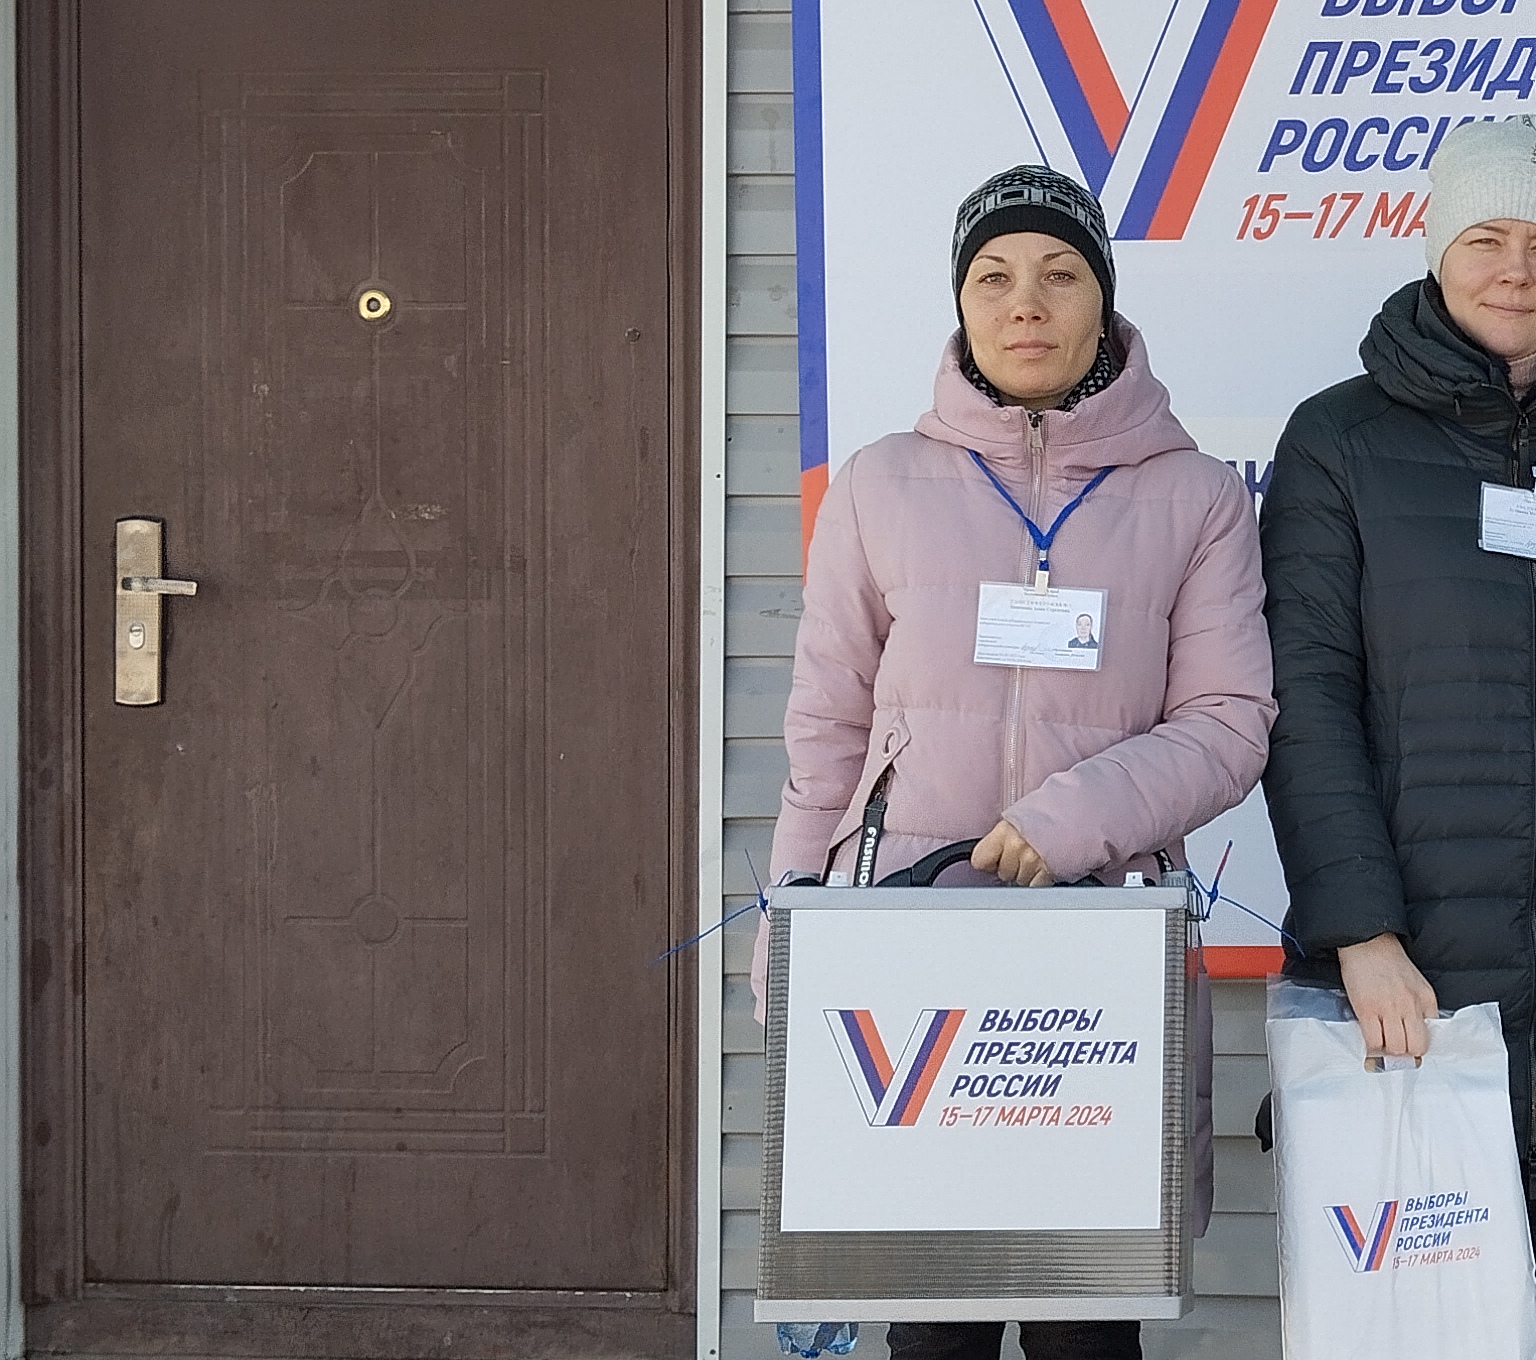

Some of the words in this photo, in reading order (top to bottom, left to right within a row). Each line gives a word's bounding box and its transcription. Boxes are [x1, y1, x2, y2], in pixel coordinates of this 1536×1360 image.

[1256, 114, 1517, 173] РОСС
[978, 1008, 1104, 1033] ВЫБОРЫ
[963, 1040, 1139, 1069] ПРЕЗИДЕНТА
[948, 1073, 1063, 1099] РОССИИ
[993, 1105, 1062, 1127] МАРТА
[1063, 1104, 1113, 1127] 2024
[1404, 1190, 1469, 1213] ВЫБОРЫ
[1399, 1207, 1489, 1233] ПРЕЗИДЕНТА
[1395, 1230, 1452, 1253] РОССИИ
[1419, 1249, 1454, 1265] МАРТА
[1455, 1246, 1481, 1261] 2024
